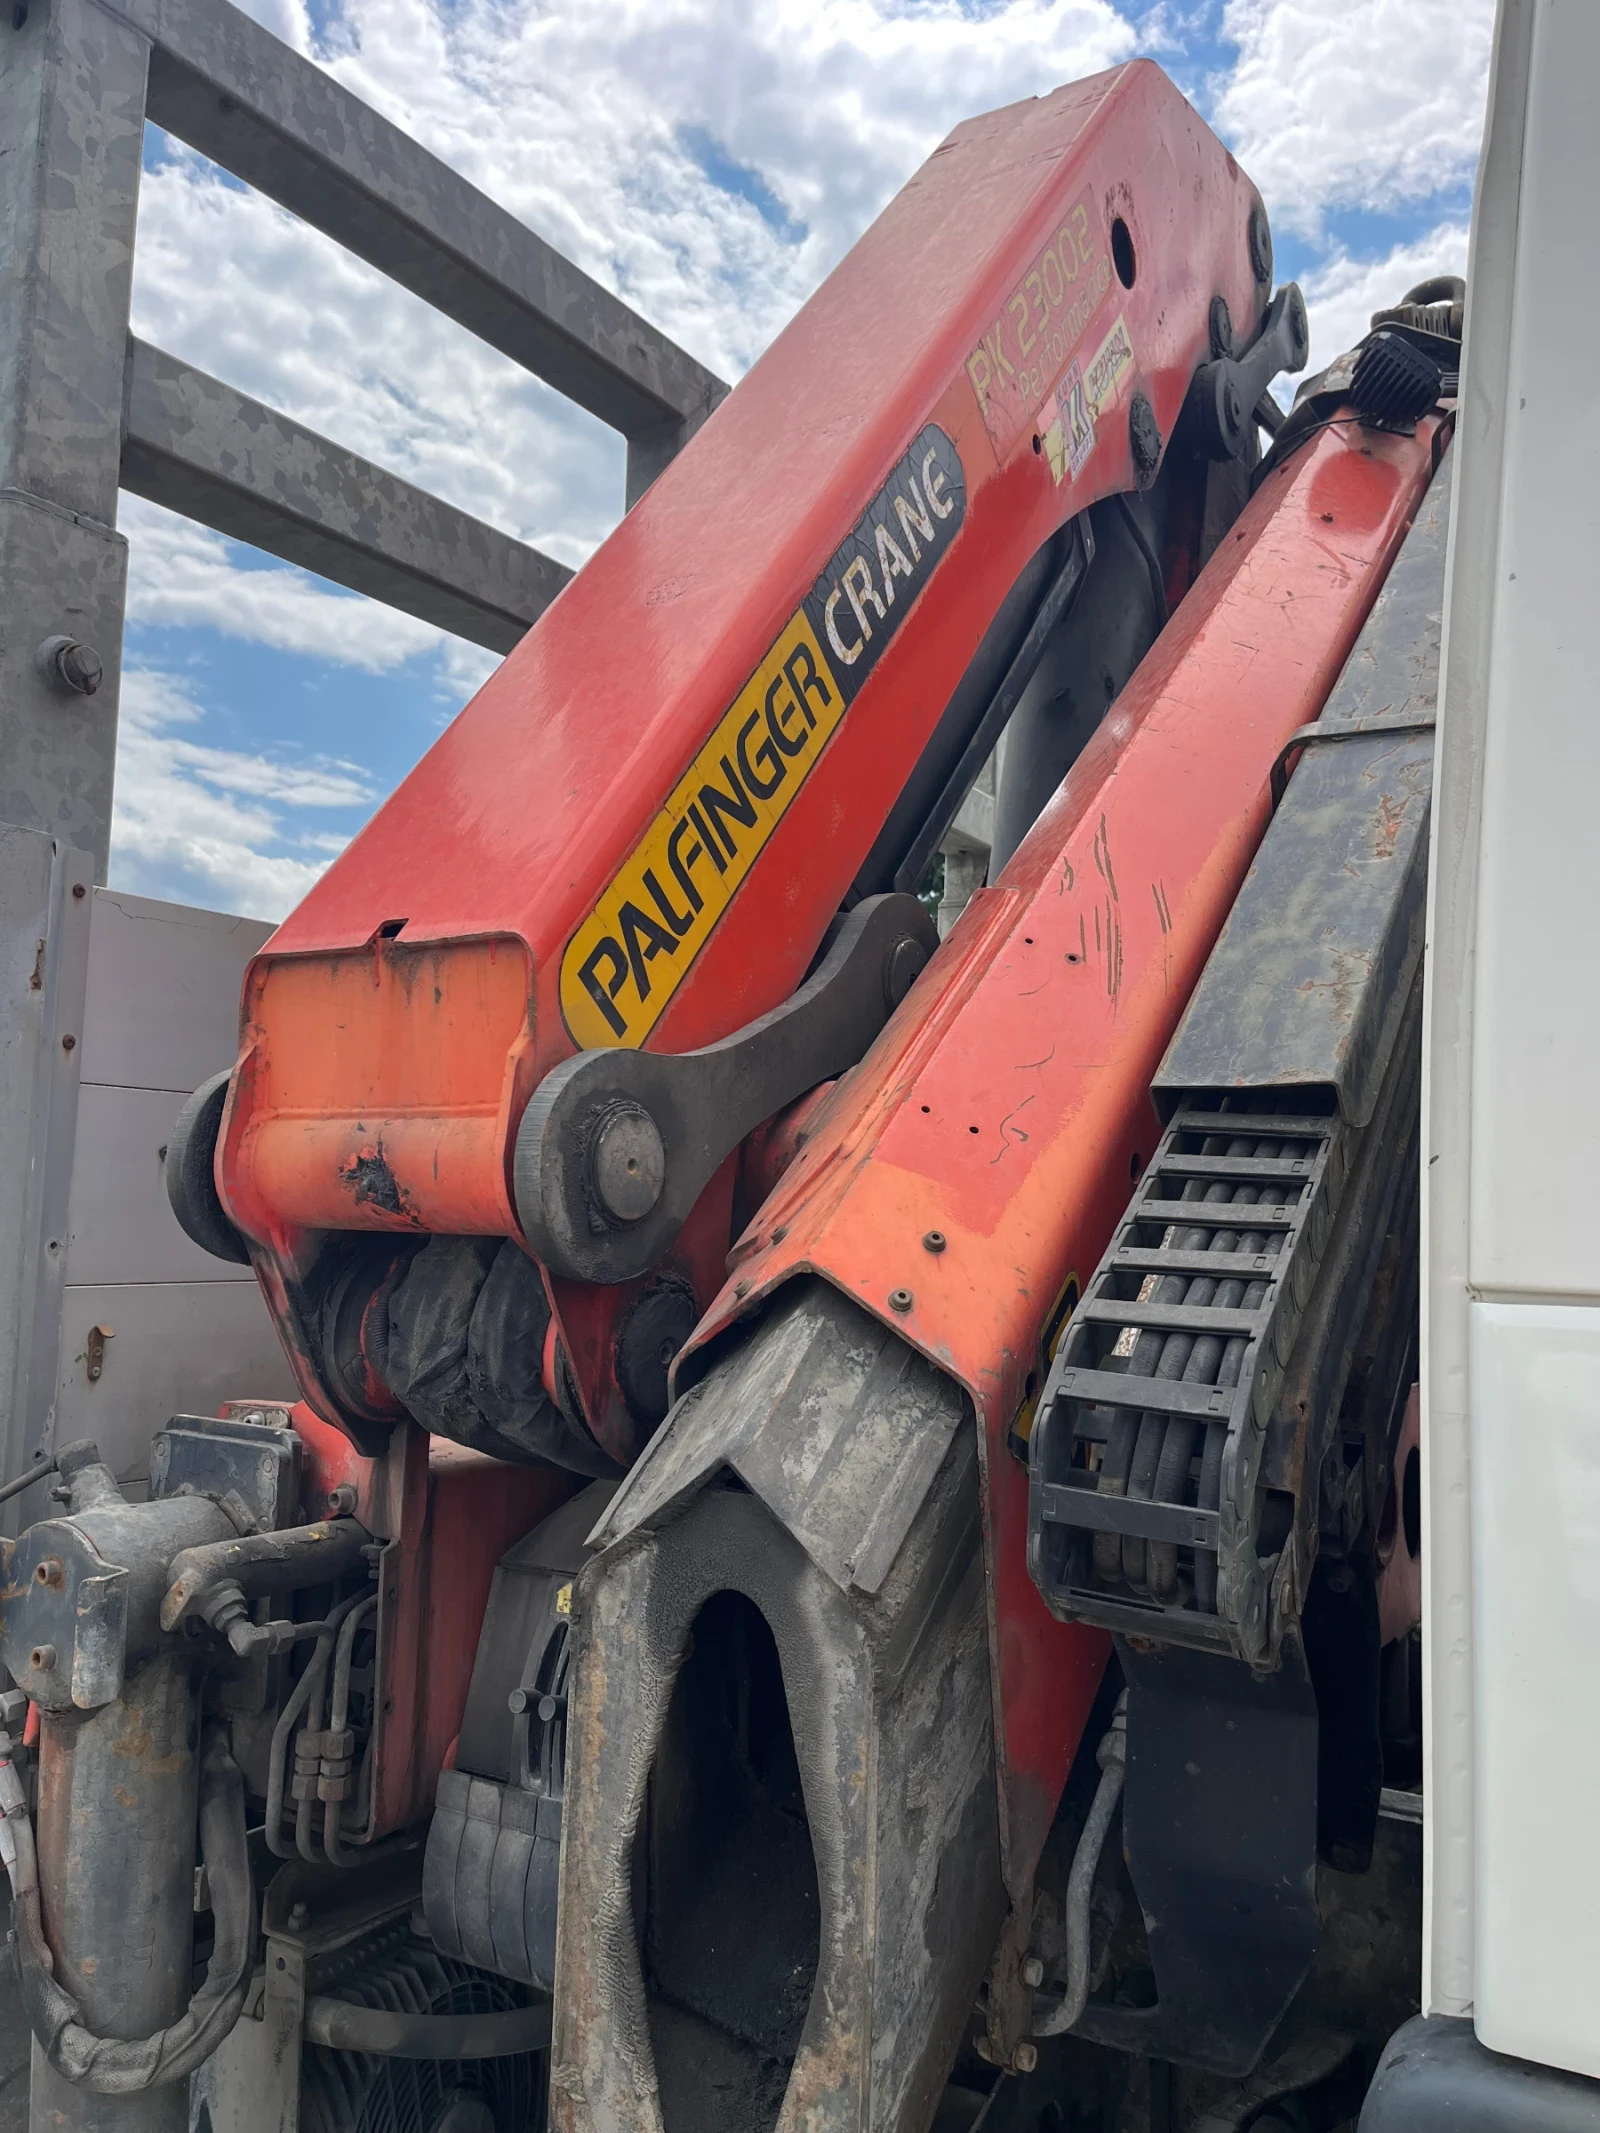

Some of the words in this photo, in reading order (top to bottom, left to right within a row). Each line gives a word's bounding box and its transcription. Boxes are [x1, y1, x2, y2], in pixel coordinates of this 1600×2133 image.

[967, 319, 1016, 417] PK
[1008, 203, 1095, 358] 23002
[1018, 254, 1113, 416] Performance
[1056, 361, 1080, 402] KUHN
[1072, 432, 1093, 472] GRUPPE
[576, 641, 833, 1039] PALFINGER
[823, 446, 955, 666] CRANE
